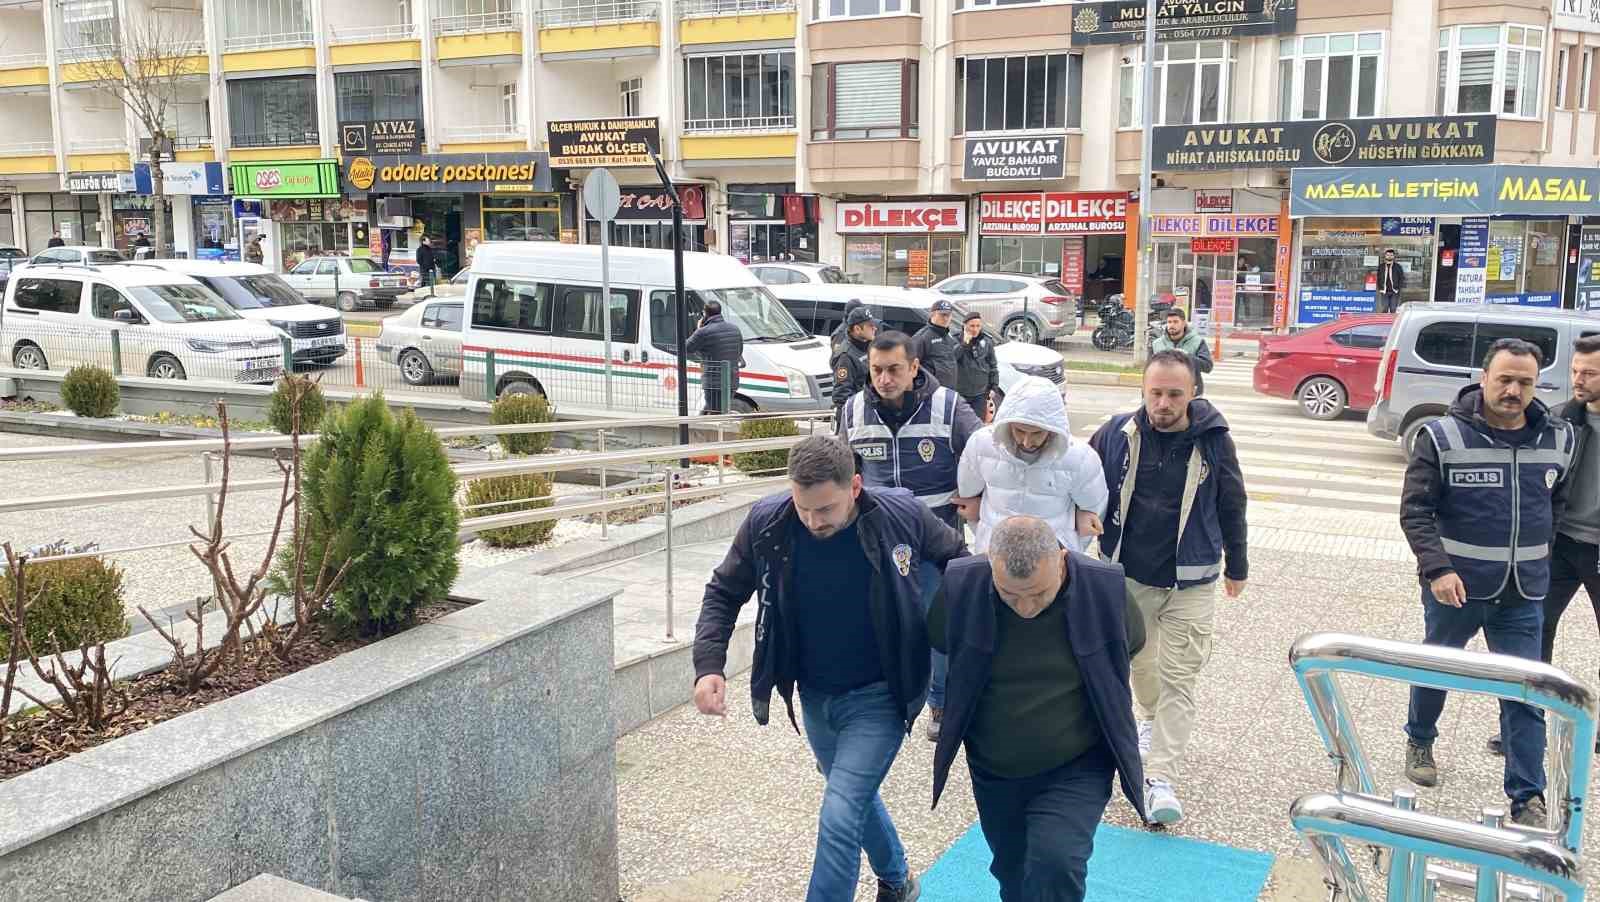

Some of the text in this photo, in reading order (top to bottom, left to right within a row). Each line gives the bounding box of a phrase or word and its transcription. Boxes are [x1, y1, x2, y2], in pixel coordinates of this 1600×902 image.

[1120, 0, 1244, 20] MUAT YALÇIN
[1112, 18, 1169, 29] DANIŞMLIK
[371, 121, 416, 135] AYVAZ
[551, 119, 656, 134] ÖLÇER HUKUK & DANIŞMANLIK
[1368, 121, 1479, 141] AVUKAT
[580, 131, 626, 142] AVUKAT
[1184, 128, 1284, 146] AVUKAT
[562, 141, 646, 155] BURAK ÖLÇER
[972, 140, 1059, 155] AVUKAT
[1359, 142, 1484, 160] HÜSEYİN GÖKKAYA
[972, 154, 1058, 166] YAVUZ BAHADIR
[1166, 150, 1204, 165] NİHAT
[381, 160, 536, 184] adalet pastanesi
[986, 165, 1041, 177] BUĞDAYLI
[71, 175, 100, 190] KUAFÖR
[1305, 178, 1480, 202] MASAL İLETİŞİM
[1498, 176, 1592, 202] MASAL
[844, 203, 959, 231] DİLEKÇE
[982, 222, 1012, 231] ARZUHAL
[1048, 222, 1088, 231] ARZUHAL
